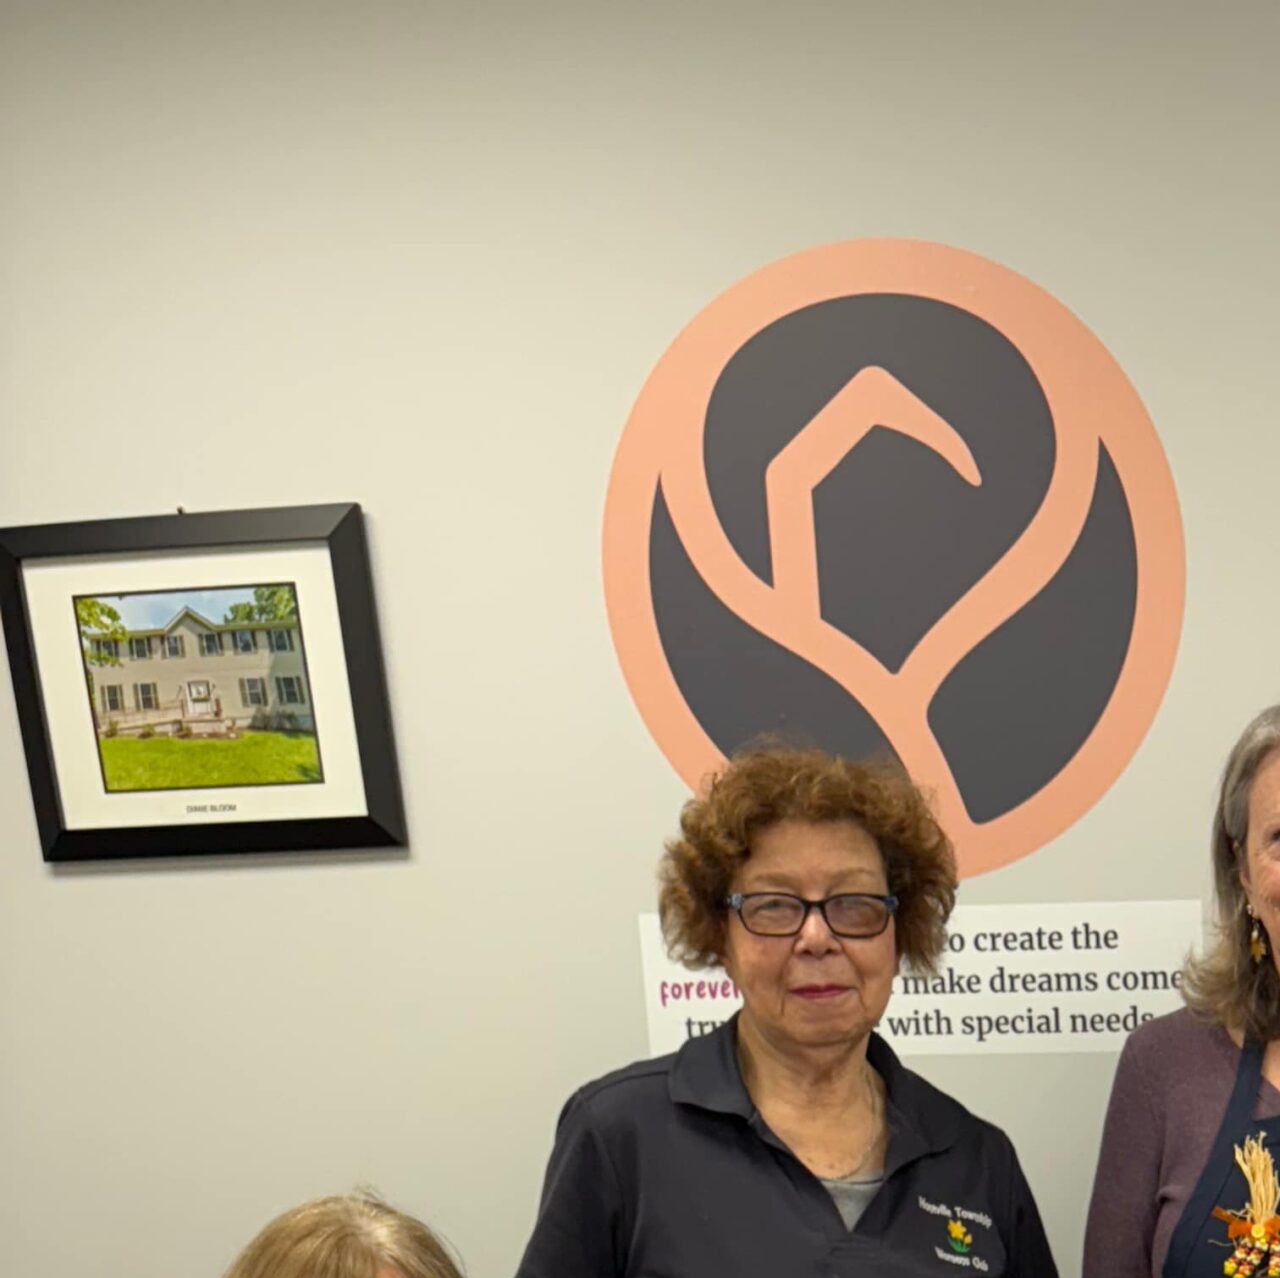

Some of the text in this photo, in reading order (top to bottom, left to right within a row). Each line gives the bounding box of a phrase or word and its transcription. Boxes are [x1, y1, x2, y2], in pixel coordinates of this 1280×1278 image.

[973, 926, 1063, 952] create
[1071, 922, 1119, 950] the
[903, 967, 982, 996] make
[989, 966, 1099, 993] dreams
[1106, 969, 1184, 991] come
[888, 1008, 954, 1036] with
[961, 1006, 1062, 1042] special
